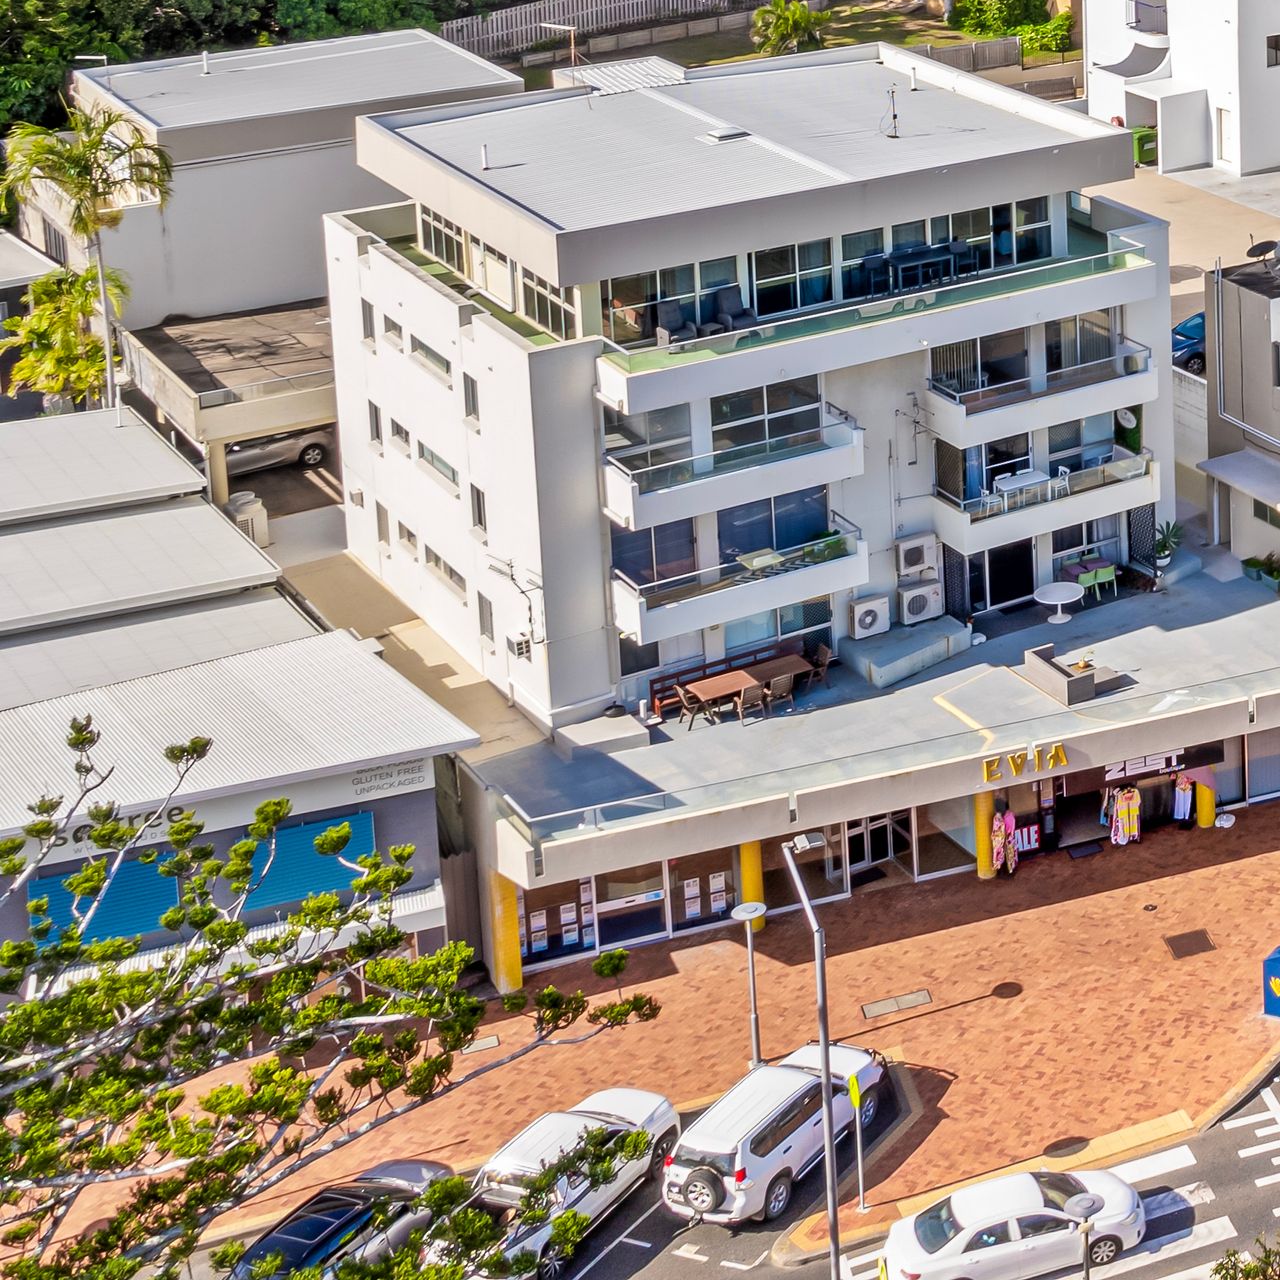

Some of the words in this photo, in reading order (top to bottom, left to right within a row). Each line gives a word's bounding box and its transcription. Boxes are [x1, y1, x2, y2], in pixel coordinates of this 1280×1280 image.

[351, 771, 393, 786] GLUTEN
[396, 764, 425, 776] FREE
[982, 742, 1068, 784] EVIA
[1104, 747, 1185, 782] ZEST
[355, 775, 426, 796] UNPACKAGED
[1014, 824, 1039, 852] ALE
